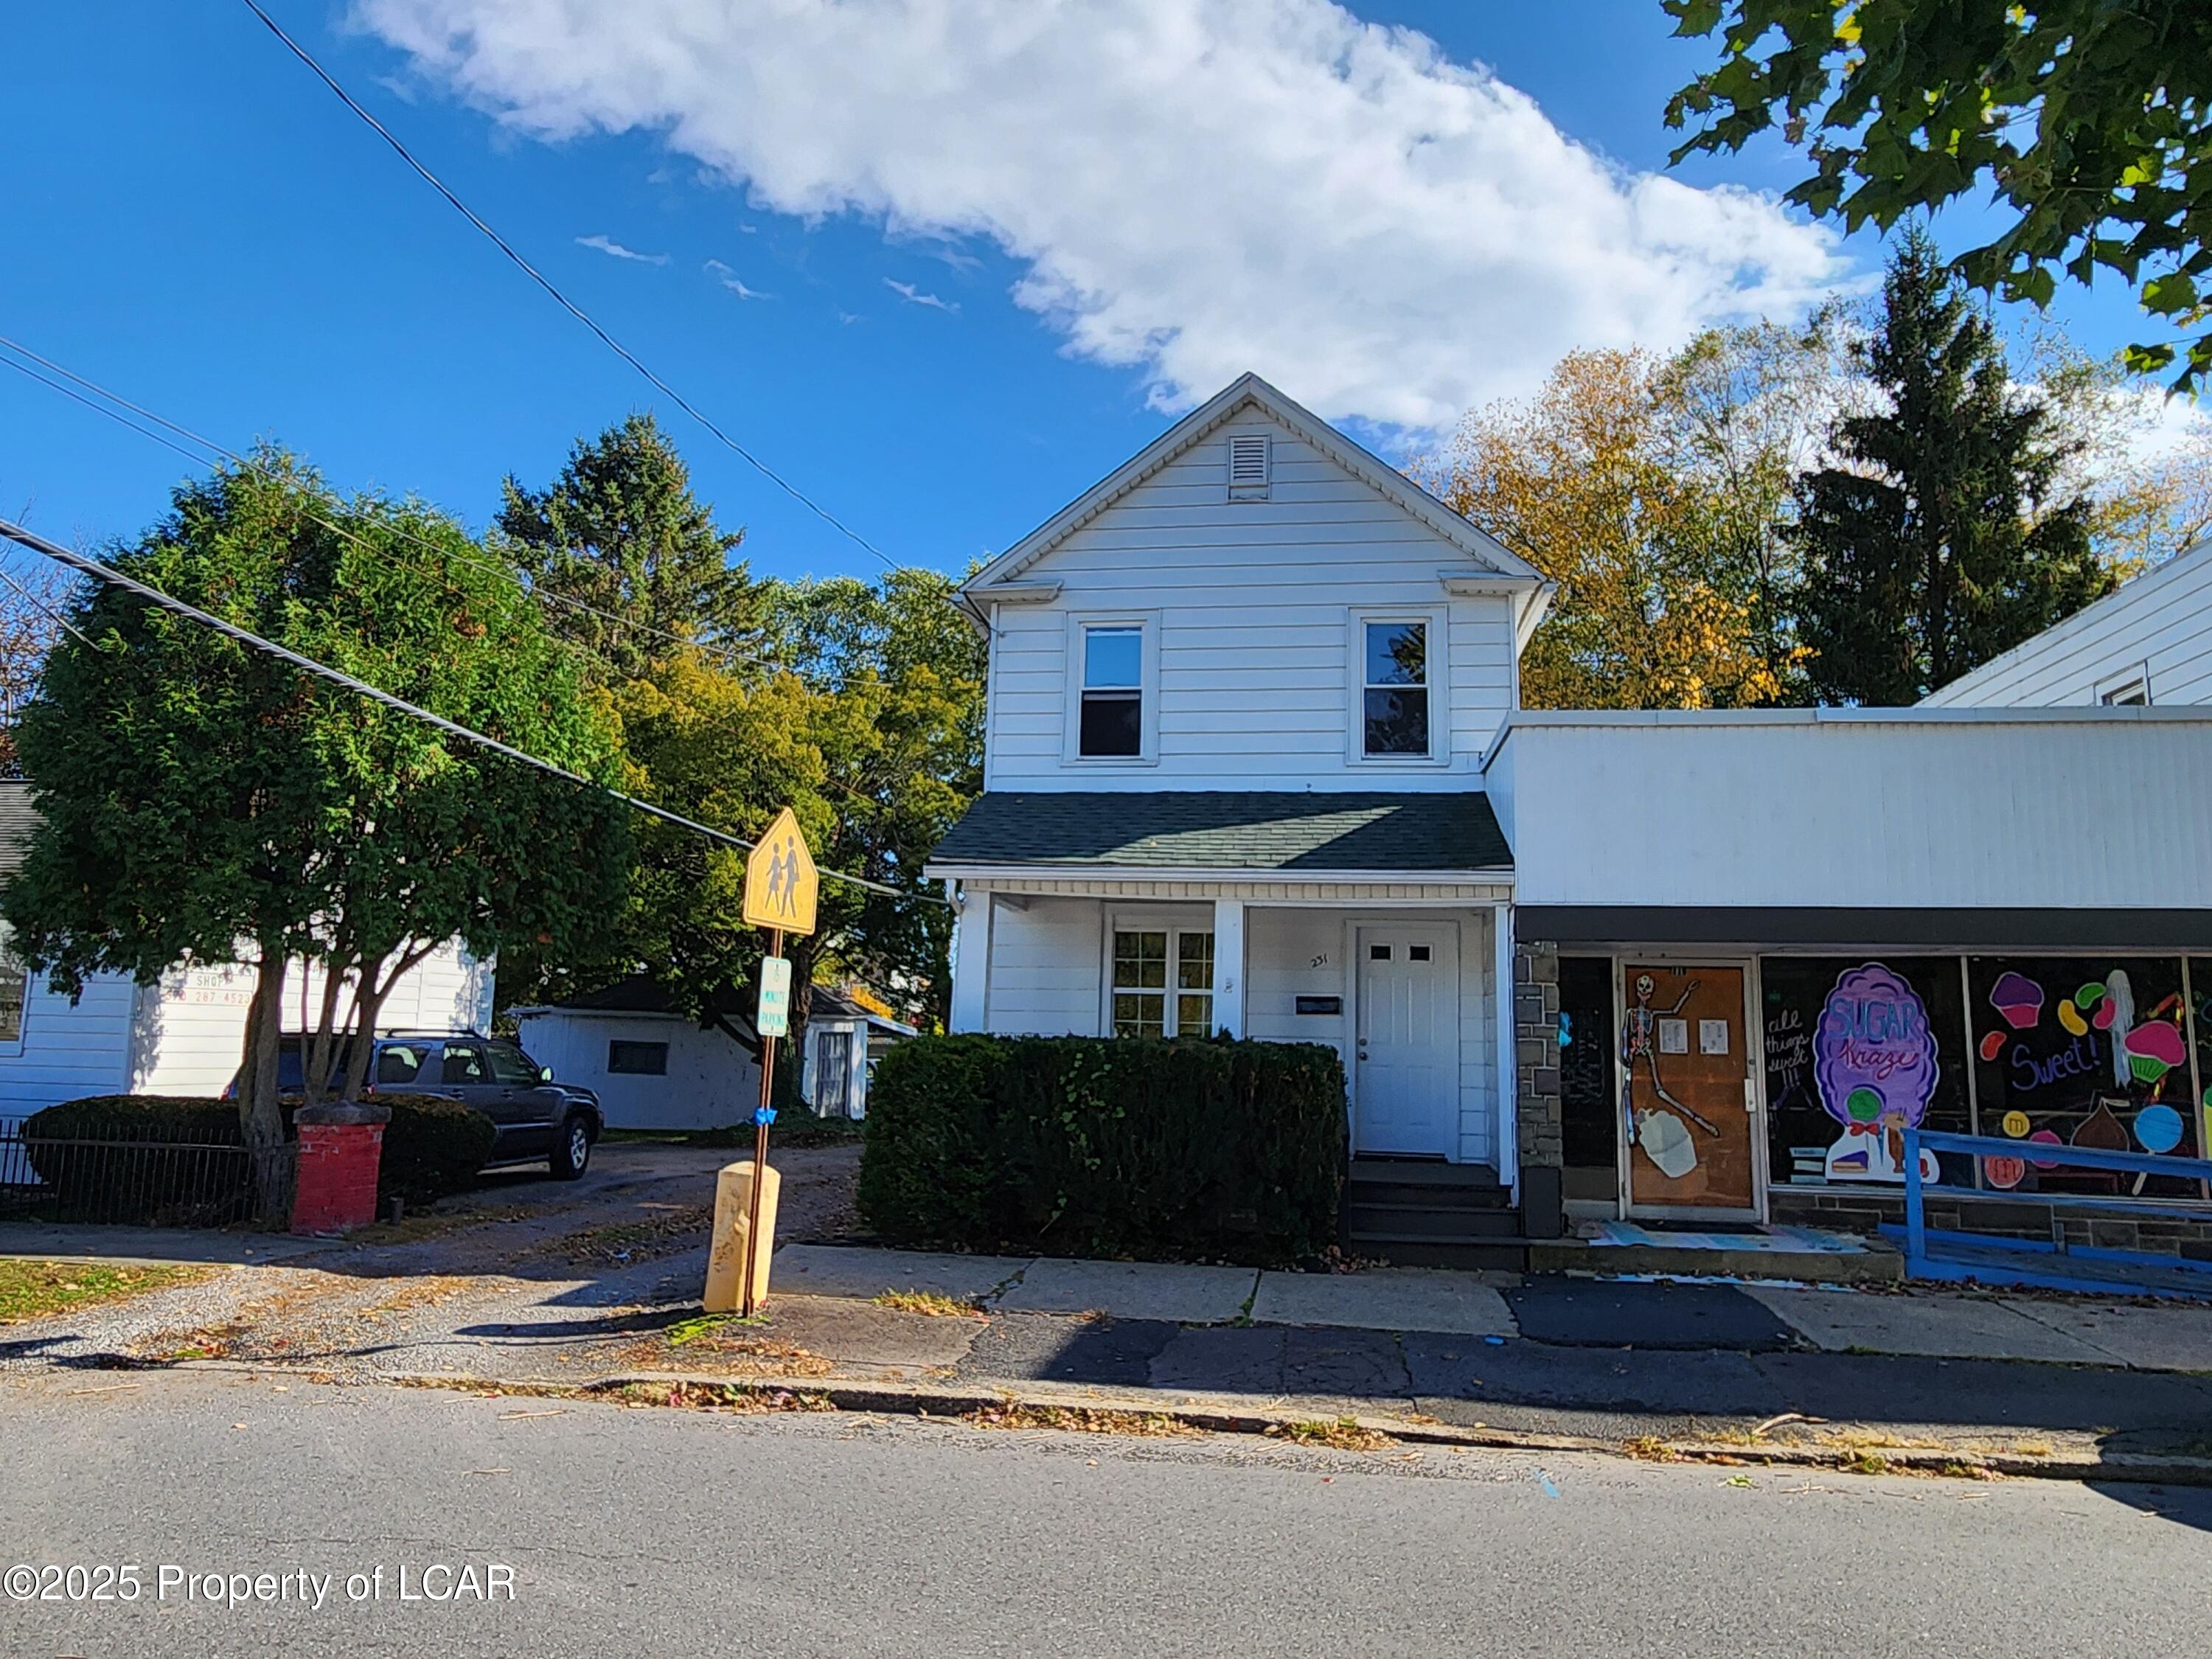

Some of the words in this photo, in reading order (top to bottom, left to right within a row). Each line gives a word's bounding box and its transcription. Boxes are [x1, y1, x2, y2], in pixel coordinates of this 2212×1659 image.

[196, 975, 224, 987] SHOP
[196, 992, 216, 1003] 287
[1769, 1009, 1803, 1033] all
[1829, 998, 1921, 1040] SUGAR
[1766, 1032, 1810, 1057] things
[1768, 1048, 1809, 1072] sweet
[2011, 1034, 2101, 1091] Sweet!
